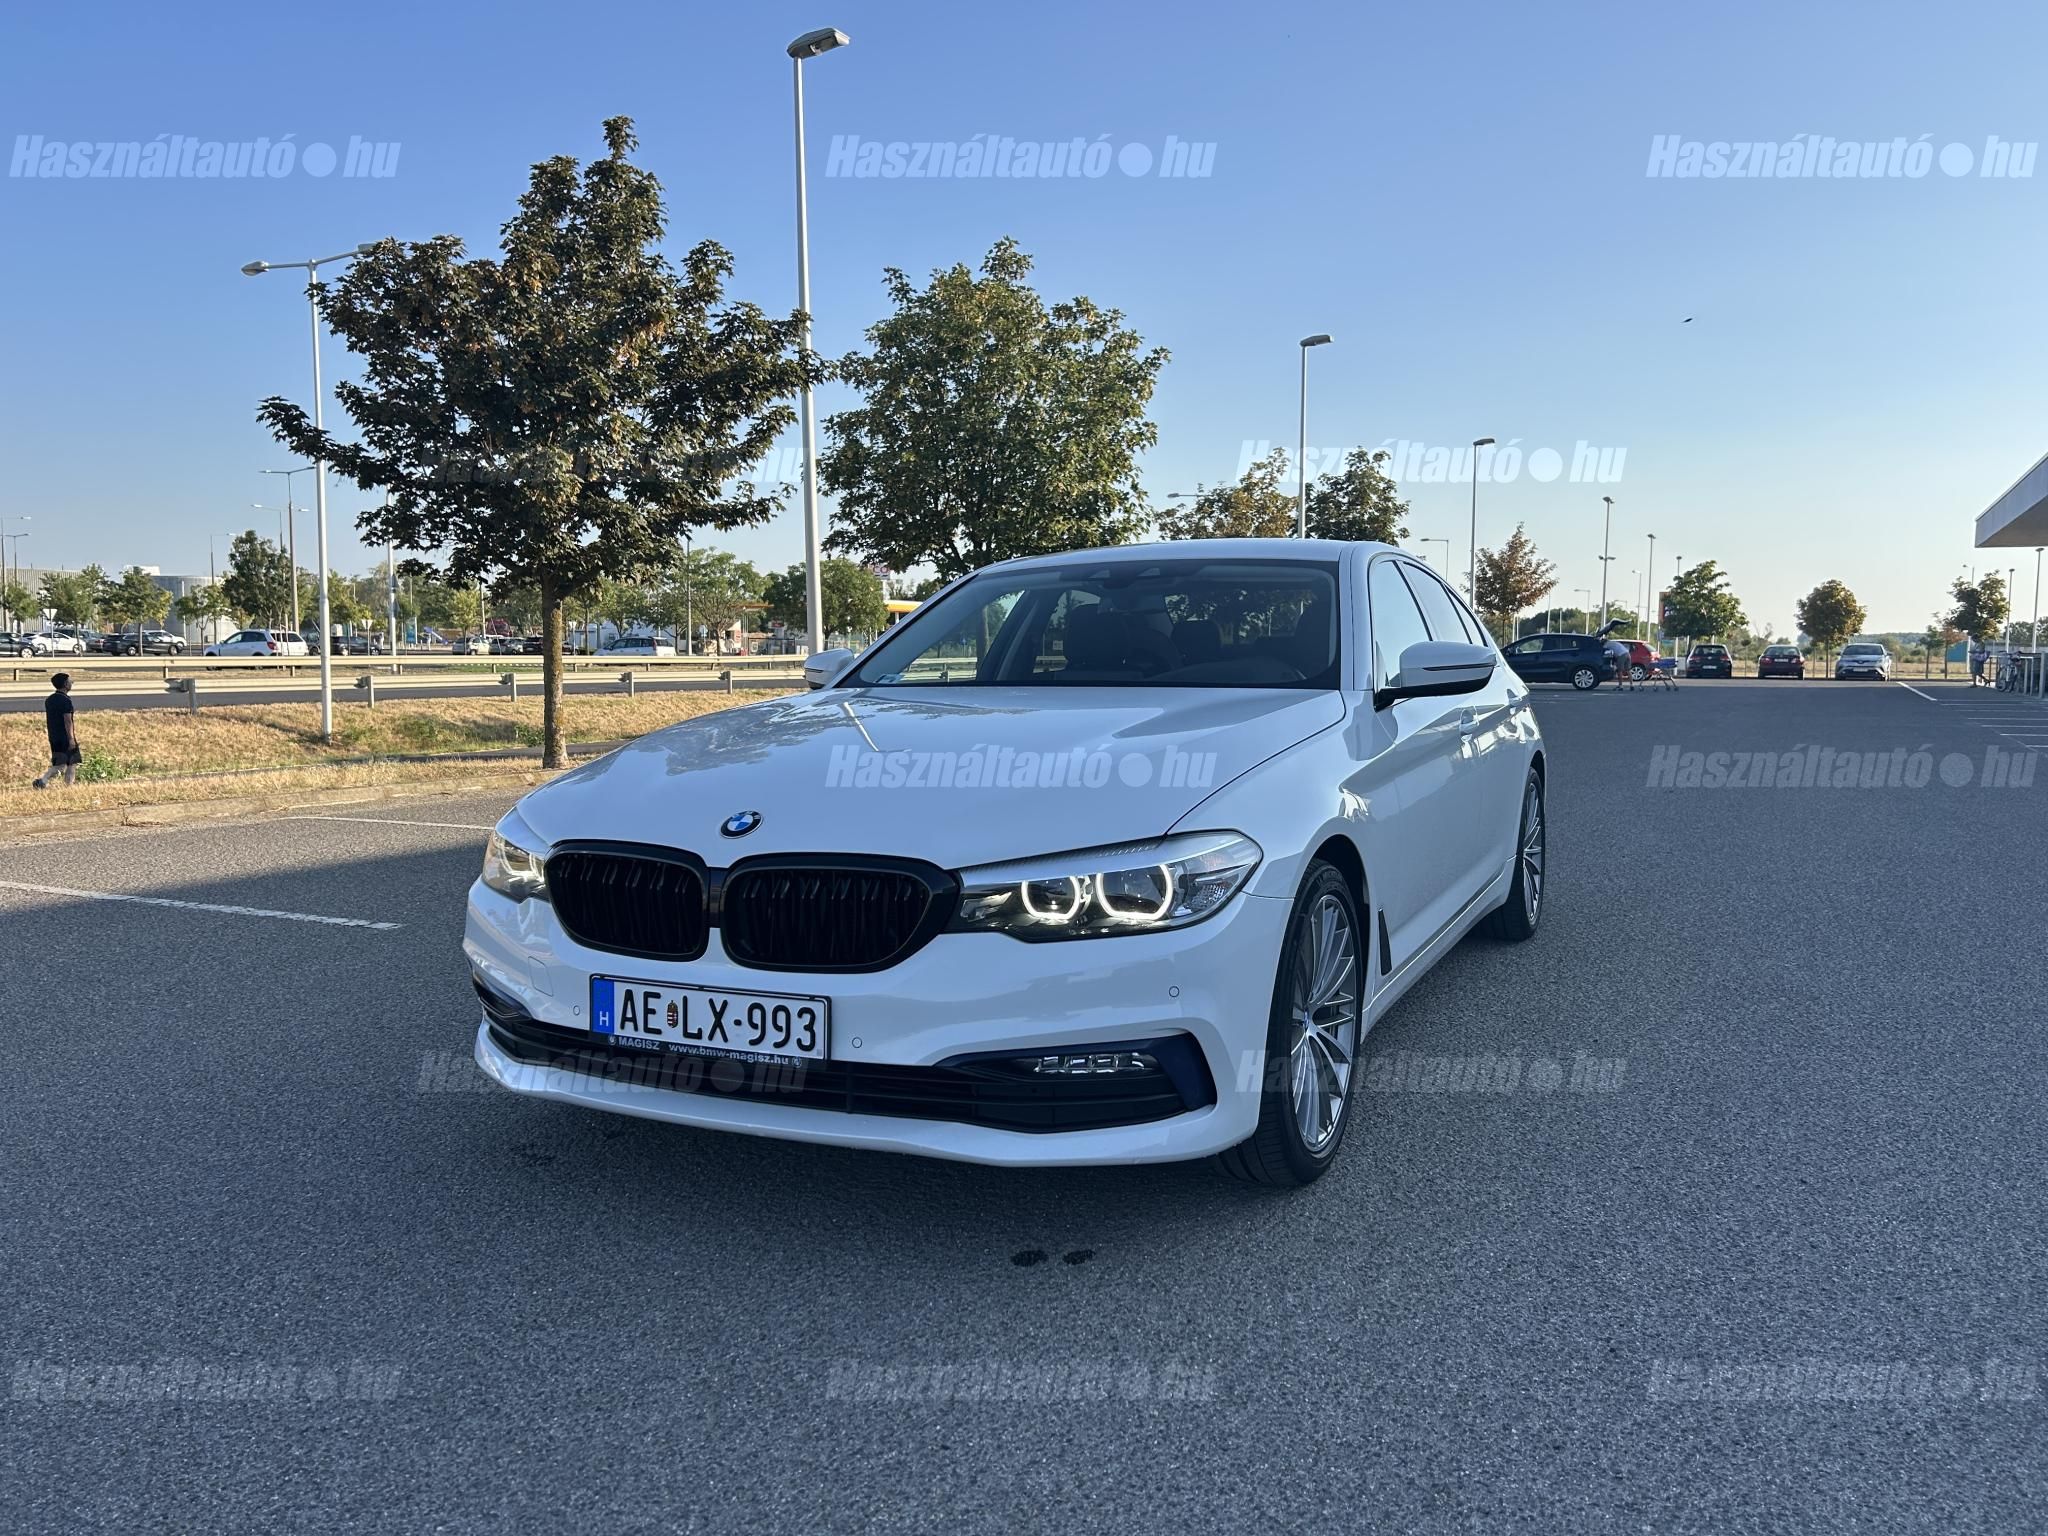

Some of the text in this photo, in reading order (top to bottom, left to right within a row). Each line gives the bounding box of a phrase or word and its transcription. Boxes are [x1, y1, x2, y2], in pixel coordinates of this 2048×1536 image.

[599, 1010, 609, 1027] H
[620, 989, 816, 1051] AE LX-993
[618, 1036, 789, 1066] MAGISZ www.bmw-magisz.hu
